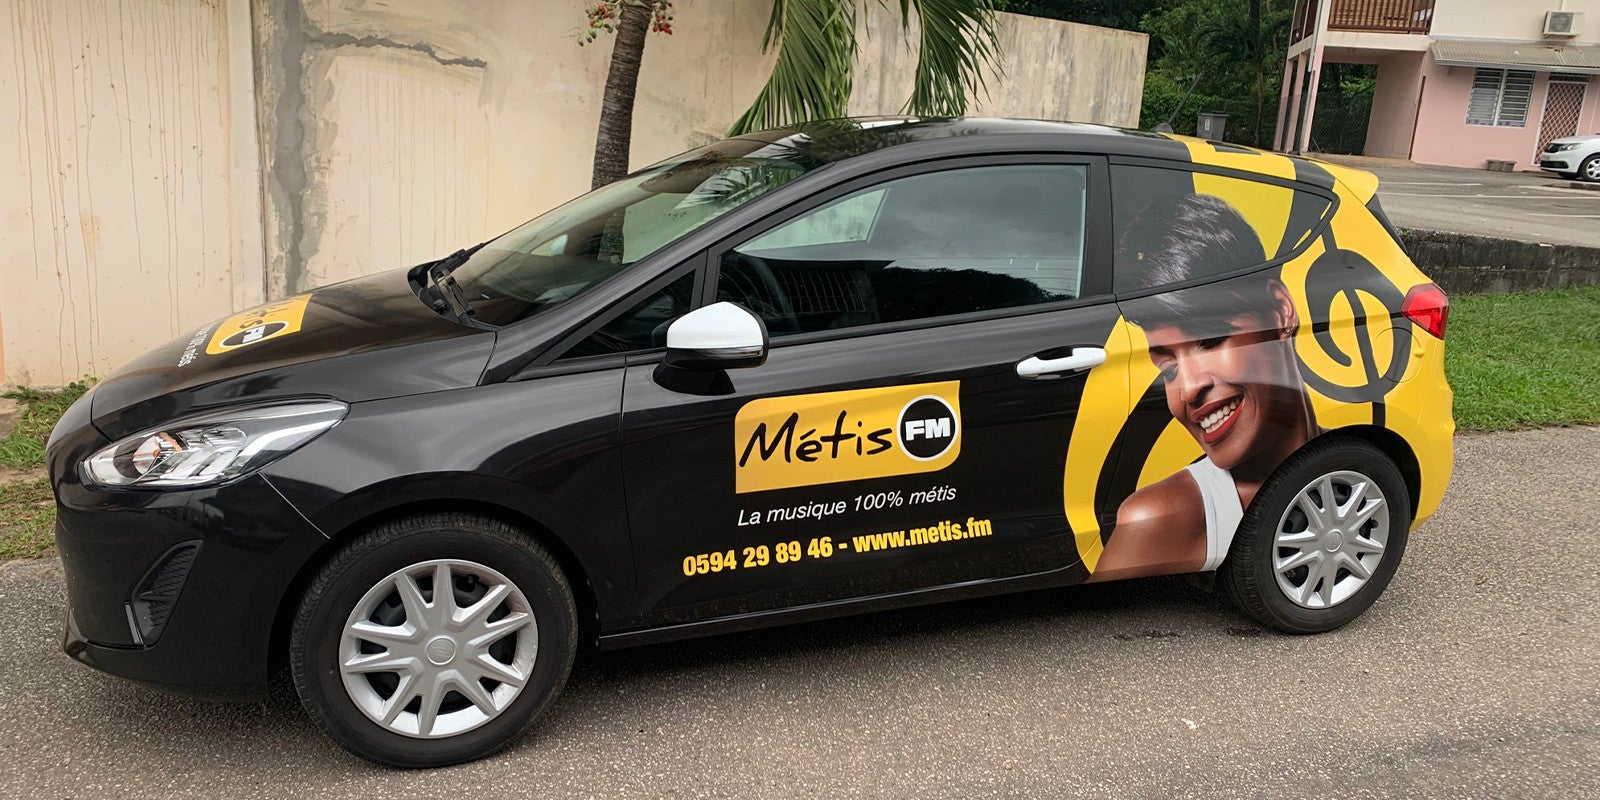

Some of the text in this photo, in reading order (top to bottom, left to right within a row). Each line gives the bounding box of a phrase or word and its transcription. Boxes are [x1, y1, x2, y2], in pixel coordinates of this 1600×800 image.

[739, 410, 951, 468] Métis FM
[737, 485, 957, 527] La musique 100% métis
[683, 550, 737, 577] 0594
[743, 545, 770, 569] 29
[776, 541, 802, 564] 89
[807, 537, 834, 559] 46
[853, 516, 993, 554] www.metis.fm
